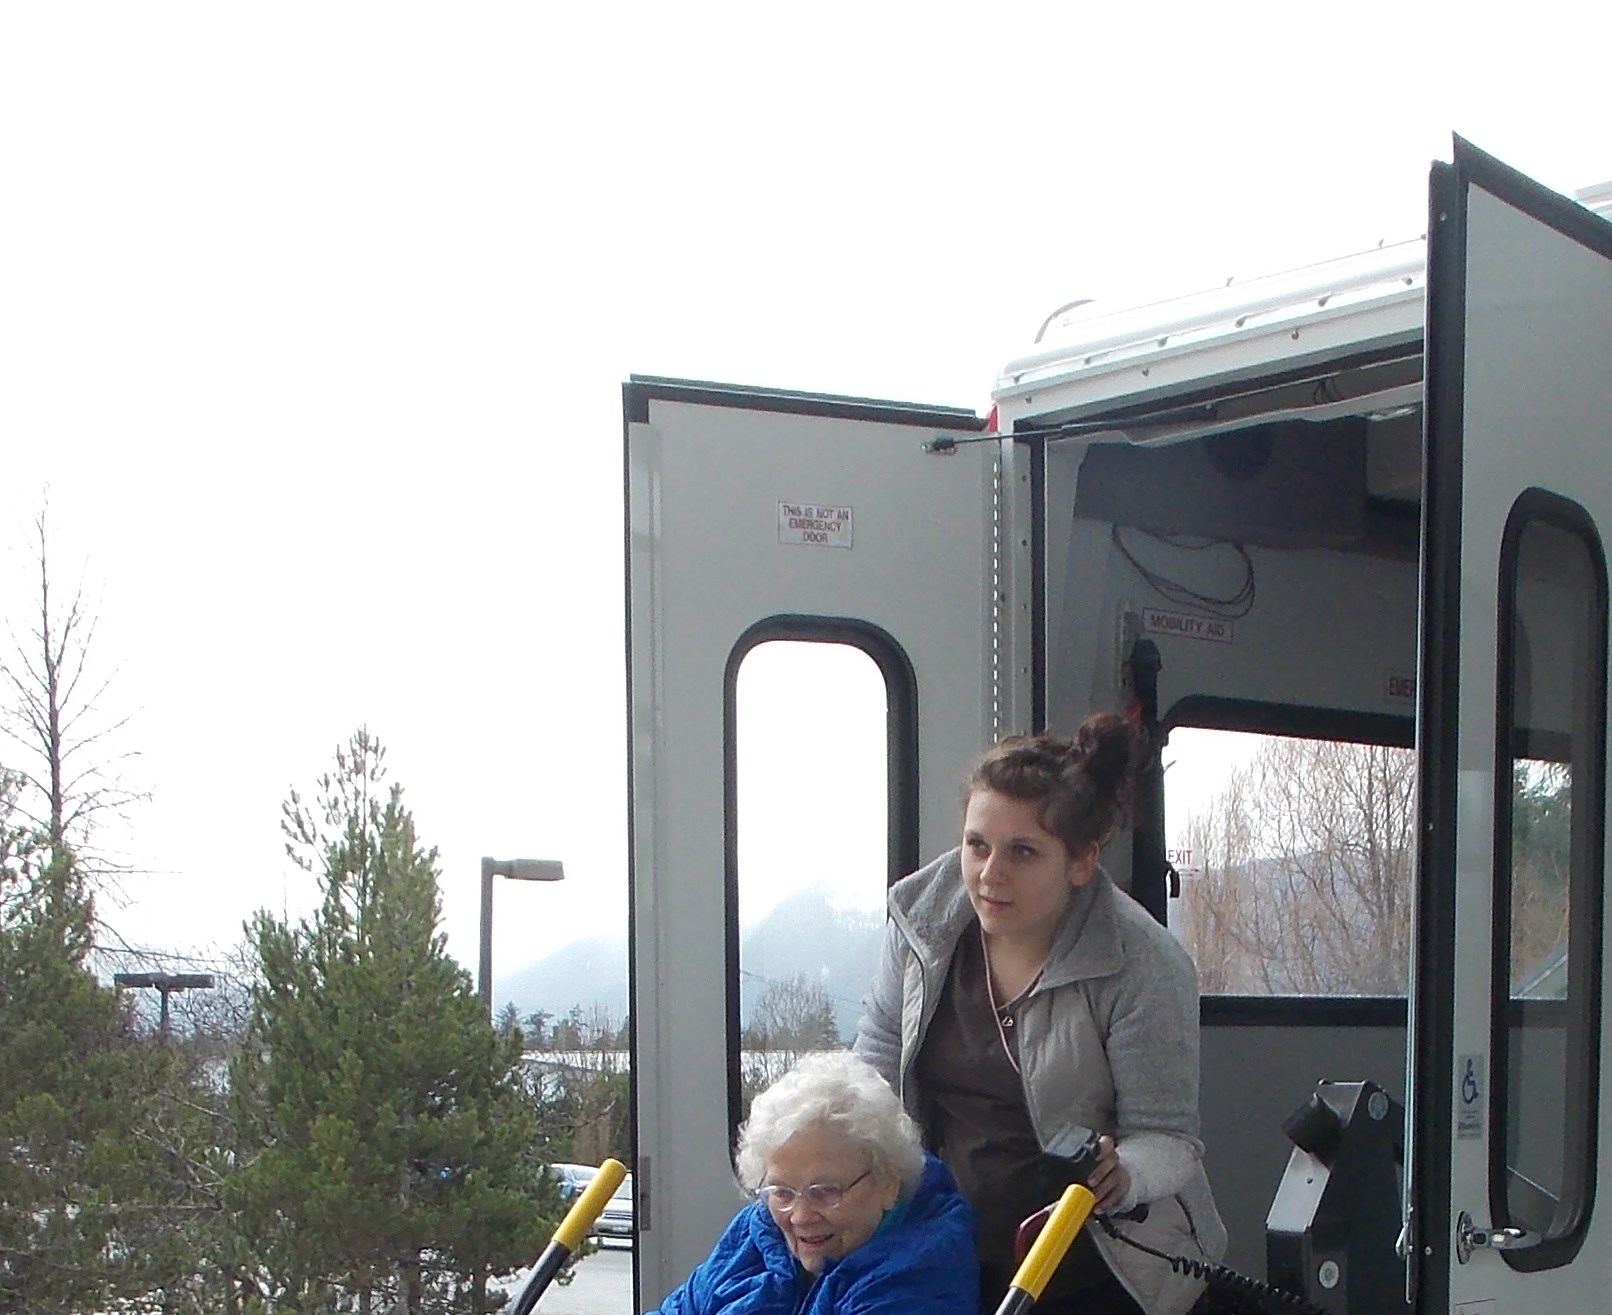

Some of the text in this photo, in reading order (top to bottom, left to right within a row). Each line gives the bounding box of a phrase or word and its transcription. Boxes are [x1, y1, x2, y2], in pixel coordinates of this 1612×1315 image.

[805, 507, 813, 518] IS
[817, 508, 834, 519] NOT
[837, 510, 849, 521] AN
[789, 517, 842, 532] EMERGENCY
[803, 531, 828, 543] DOOR
[1168, 849, 1192, 864] EXIT
